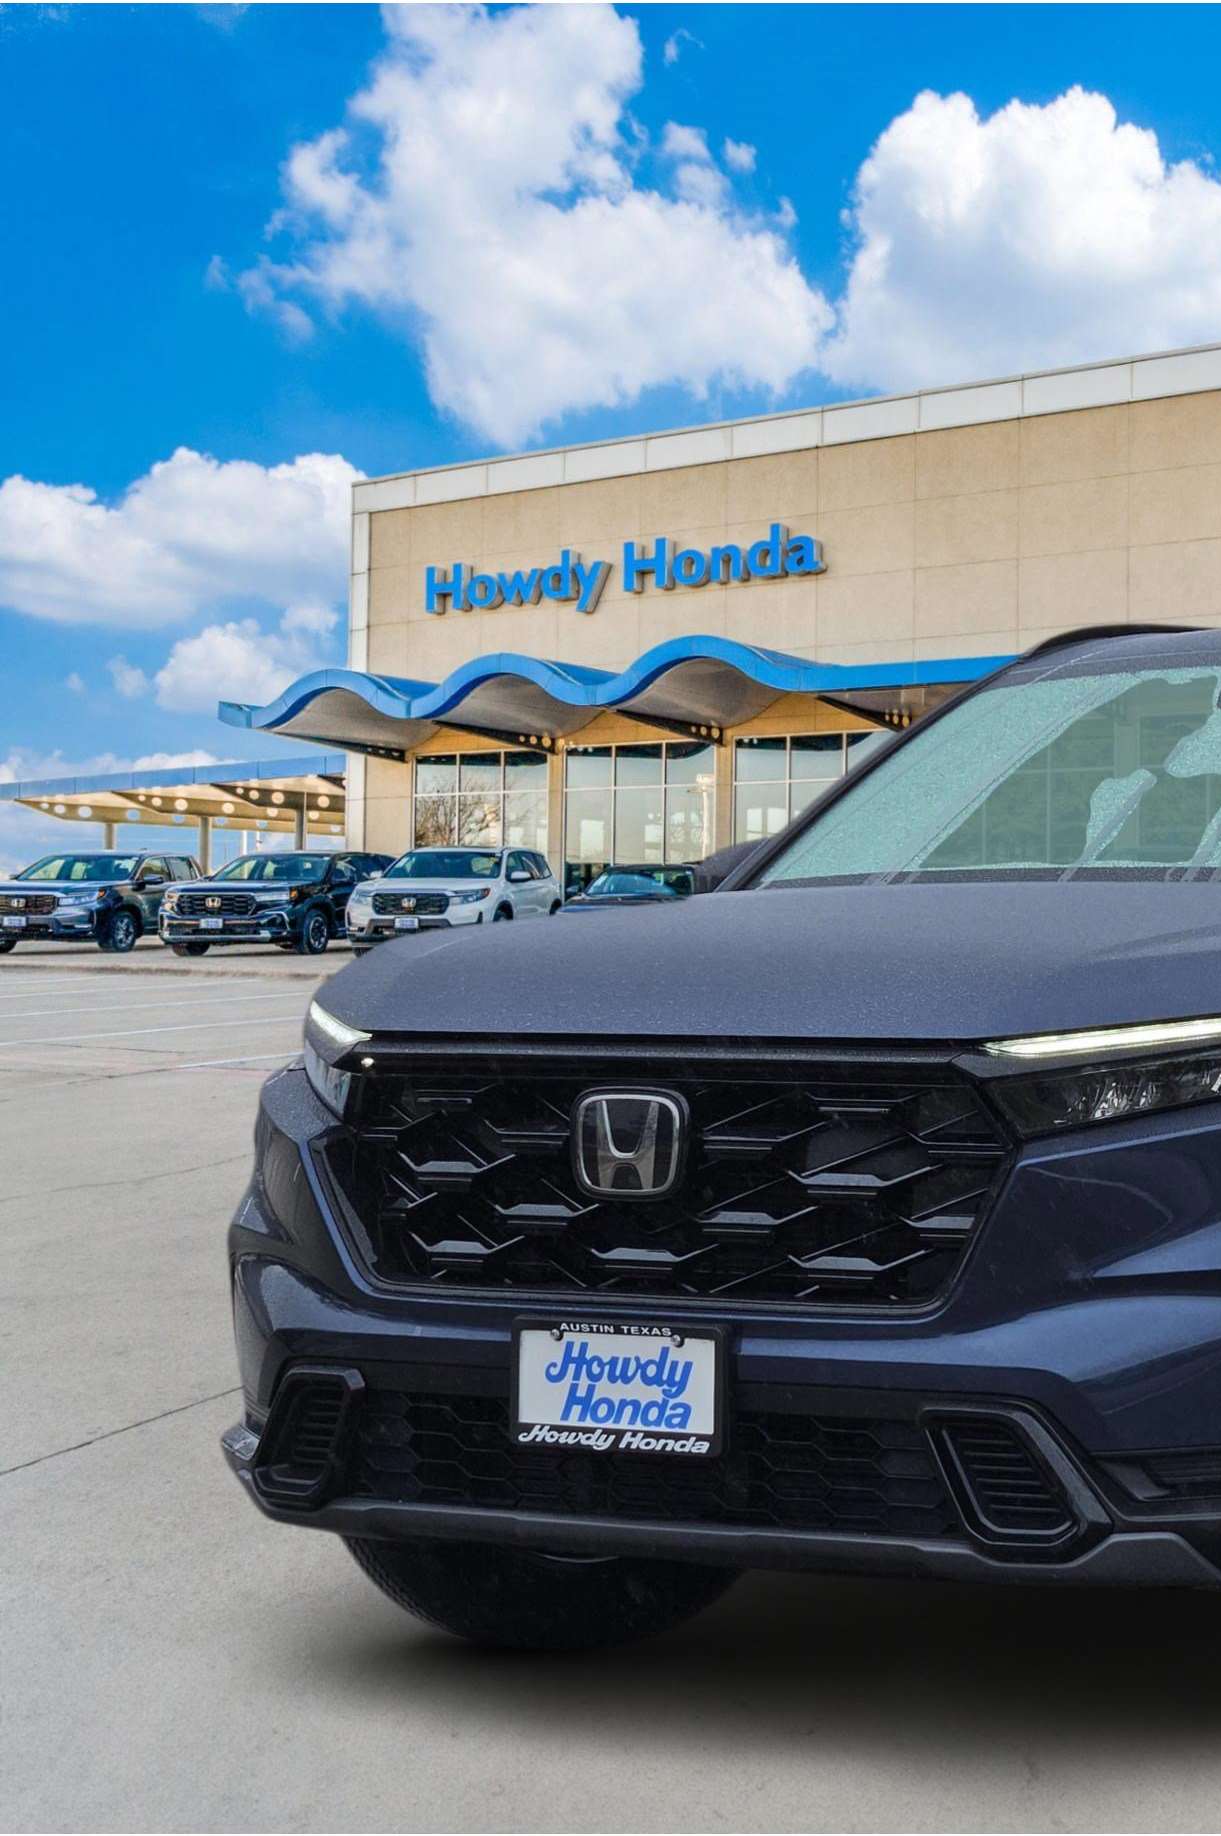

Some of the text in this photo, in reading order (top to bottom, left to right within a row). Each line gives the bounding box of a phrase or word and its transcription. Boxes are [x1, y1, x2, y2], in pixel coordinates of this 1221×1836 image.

[425, 522, 827, 615] Howdy Honda
[559, 1321, 672, 1337] AUSTIN TEXAS
[545, 1340, 694, 1399] Howdy
[560, 1382, 692, 1430] Honda
[518, 1424, 711, 1454] Howdy Honda
